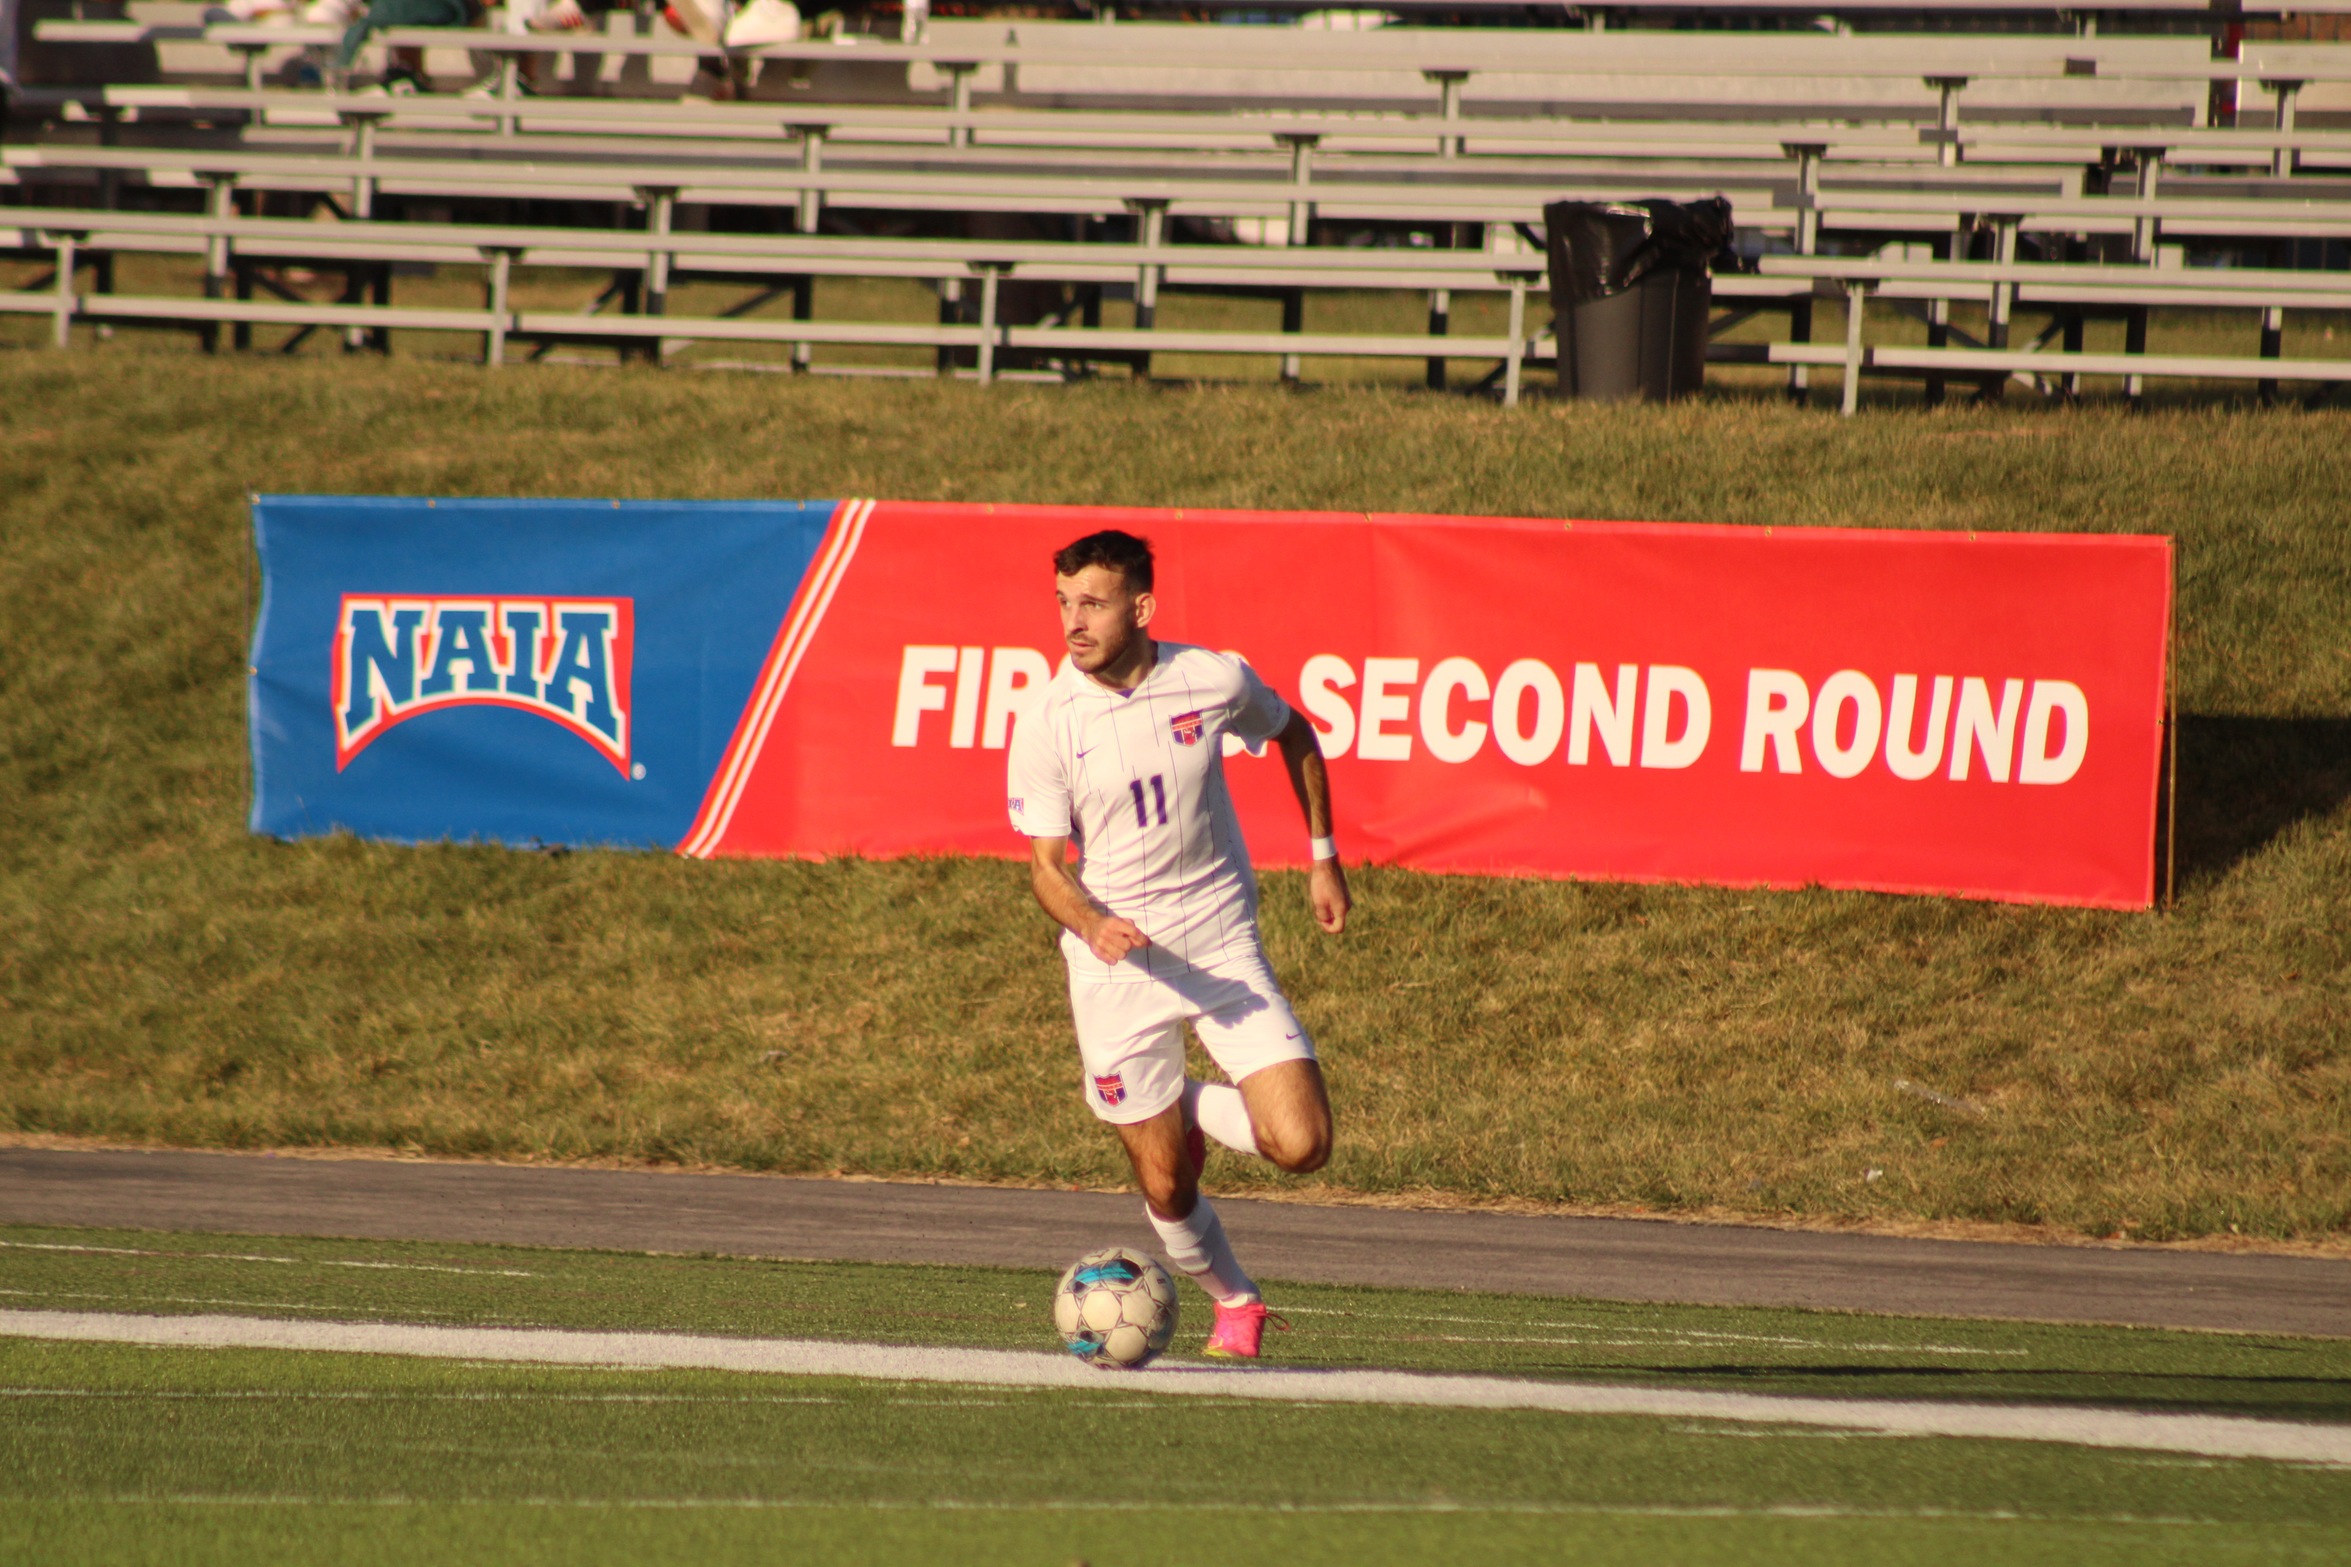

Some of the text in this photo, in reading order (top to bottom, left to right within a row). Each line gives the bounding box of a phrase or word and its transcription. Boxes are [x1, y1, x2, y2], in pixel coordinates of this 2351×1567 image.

[339, 599, 627, 760] NAIA
[891, 644, 1070, 750] FIR
[1299, 653, 1712, 770] SECOND
[1739, 667, 2090, 786] ROUND
[1129, 773, 1168, 829] 11
